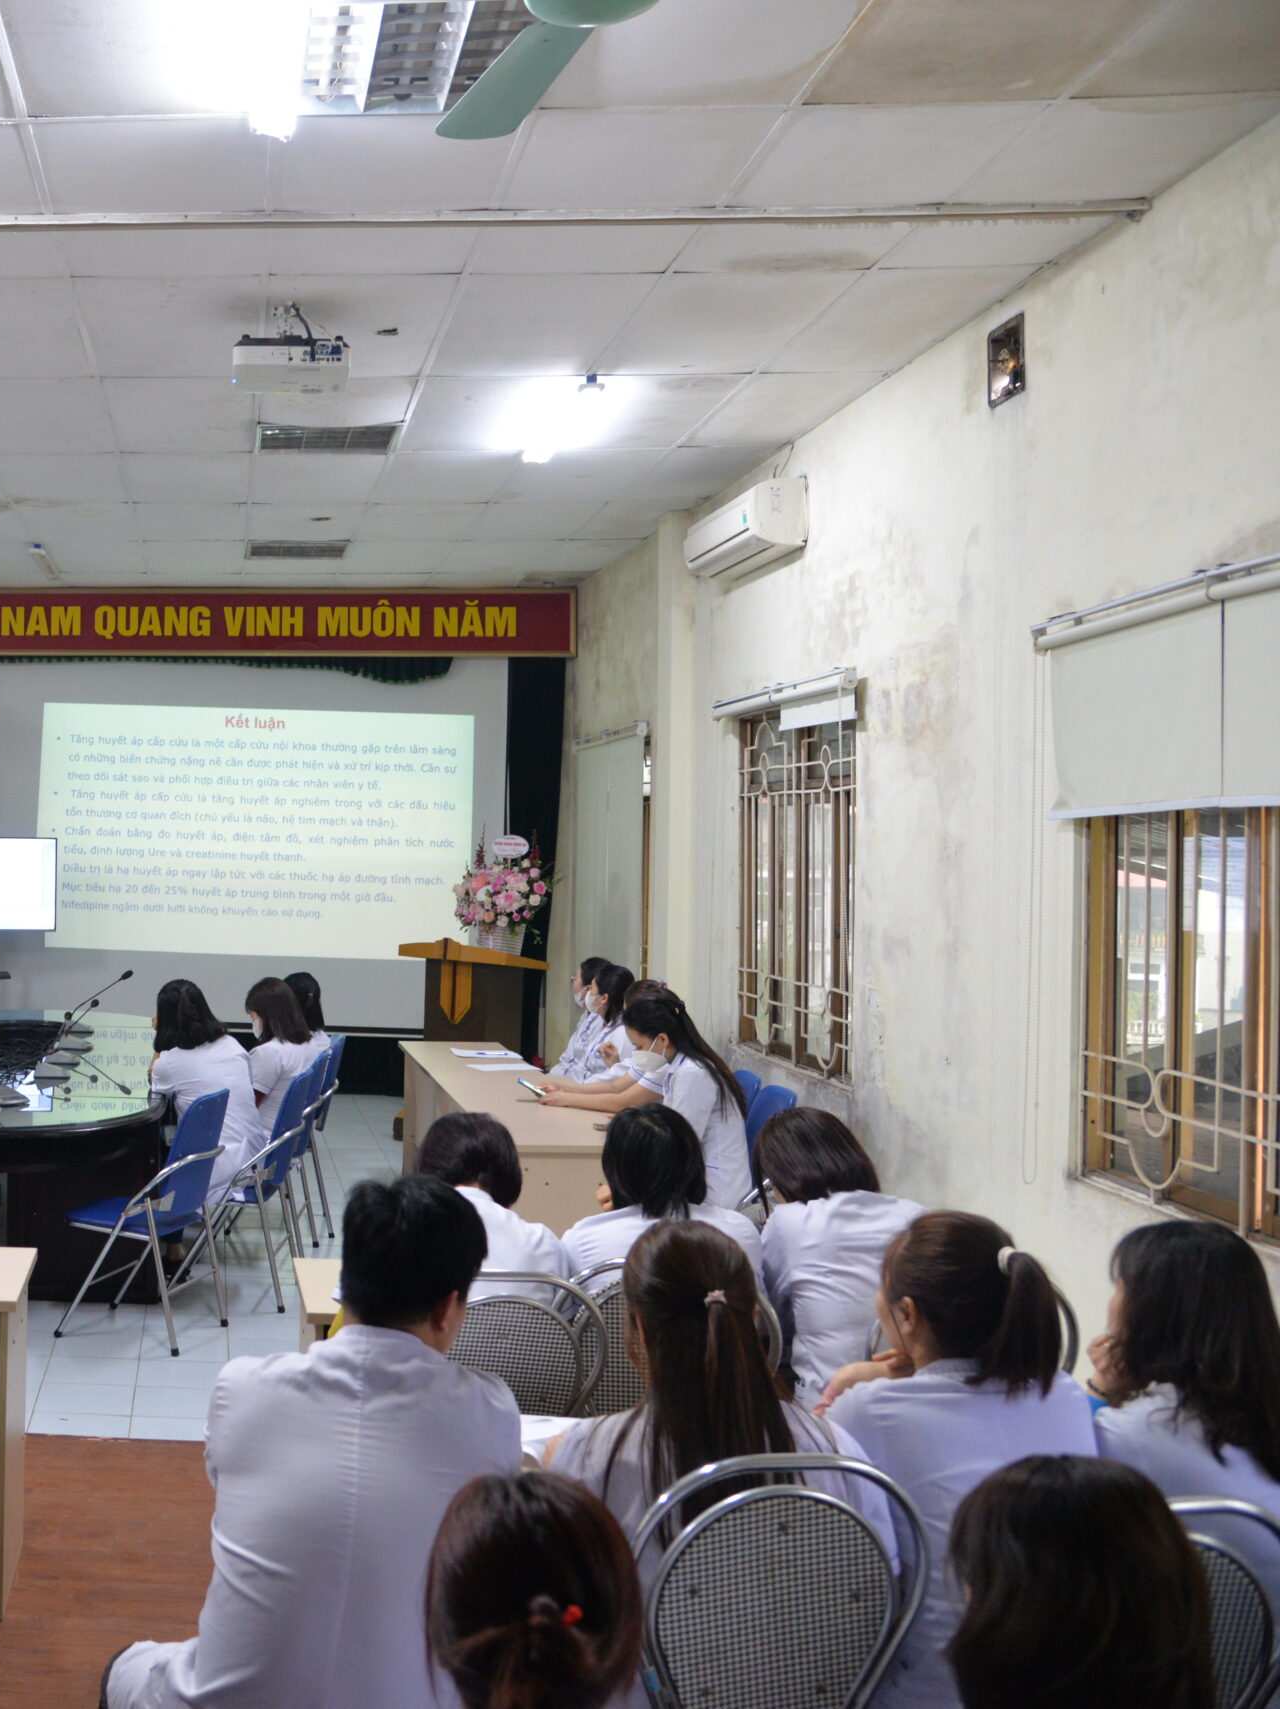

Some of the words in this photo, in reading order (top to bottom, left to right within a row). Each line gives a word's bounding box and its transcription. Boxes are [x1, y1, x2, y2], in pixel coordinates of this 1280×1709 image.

[1, 606, 81, 636] NAM
[94, 605, 211, 640] QUANG
[223, 606, 304, 637] VINH
[317, 599, 420, 637] MUÔN
[433, 600, 517, 637] NĂM
[224, 713, 250, 729] Kết
[254, 717, 286, 733] luận
[292, 741, 317, 752] khoa
[67, 771, 91, 781] theo
[131, 775, 150, 783] sao
[357, 783, 365, 792] y
[140, 812, 167, 822] quan
[298, 816, 316, 825] tim
[148, 848, 166, 858] Ure
[185, 851, 238, 861] creatinine
[273, 853, 306, 863] thanh.
[182, 870, 208, 880] ngay
[125, 884, 138, 894] 20
[164, 885, 189, 896] 25%
[240, 889, 269, 901] trung
[298, 891, 327, 903] trong
[61, 900, 110, 912] Nifedipine
